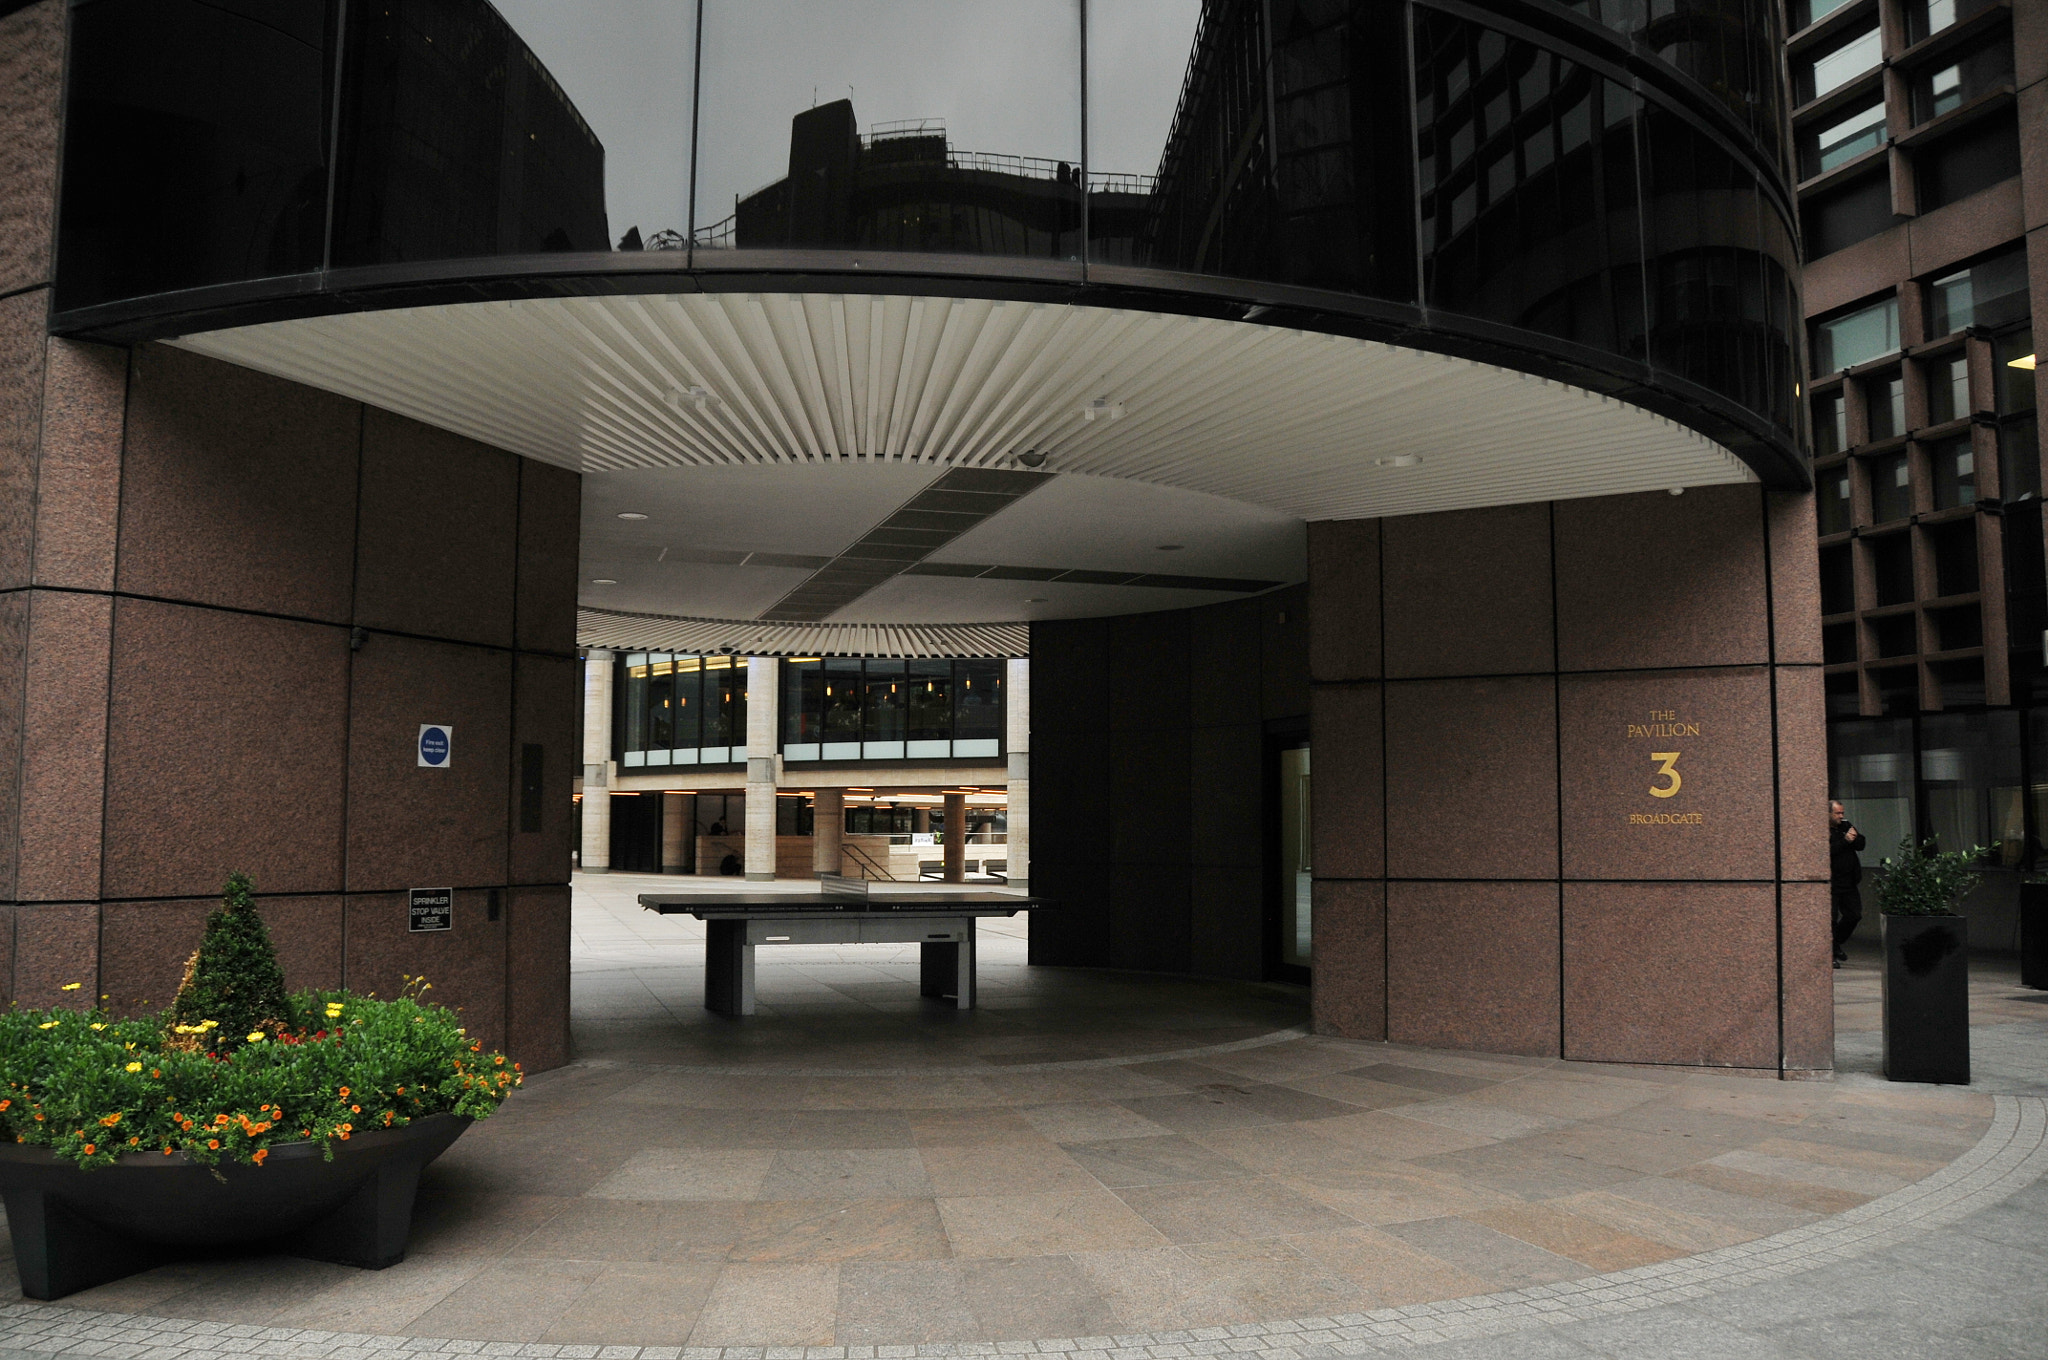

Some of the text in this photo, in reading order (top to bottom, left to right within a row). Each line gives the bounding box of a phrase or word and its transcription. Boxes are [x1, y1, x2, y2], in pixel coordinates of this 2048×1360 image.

[1649, 710, 1676, 721] THE
[1627, 722, 1701, 738] PAVILION
[1648, 751, 1682, 798] 3
[1628, 813, 1703, 825] BROADGATE
[413, 896, 449, 905] SPRINKLER
[411, 906, 450, 916] STOP VALVE
[421, 916, 441, 924] INSIDE
